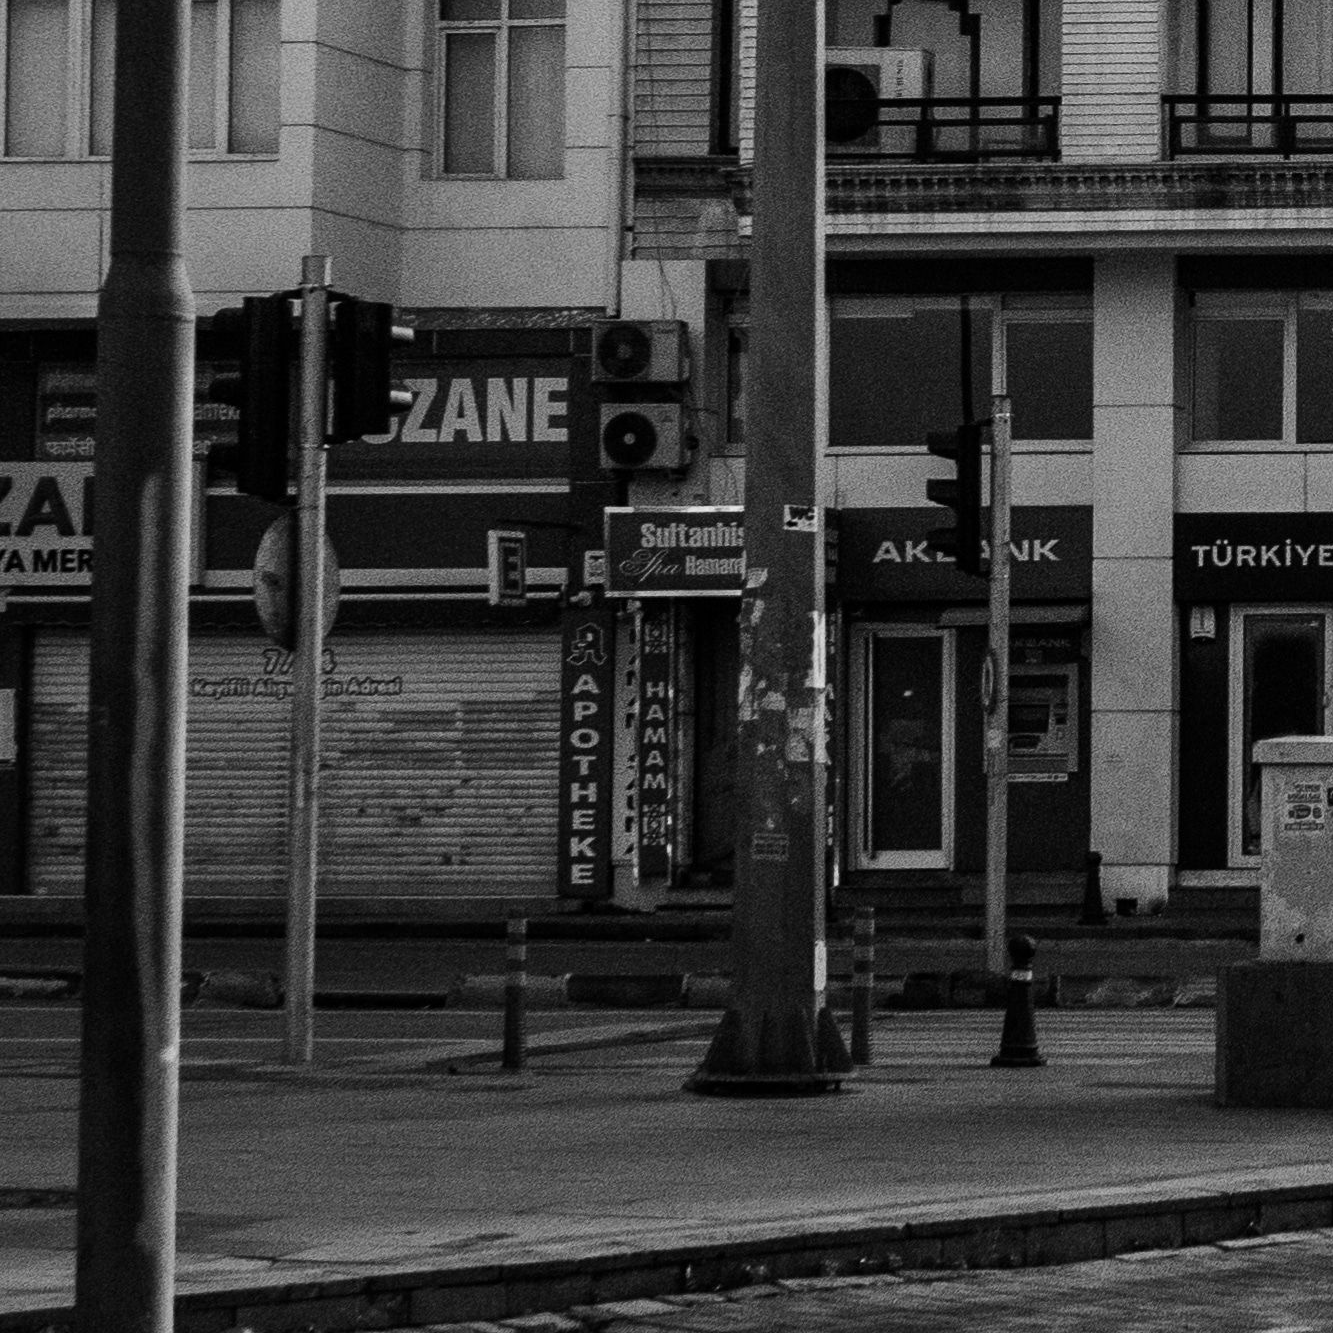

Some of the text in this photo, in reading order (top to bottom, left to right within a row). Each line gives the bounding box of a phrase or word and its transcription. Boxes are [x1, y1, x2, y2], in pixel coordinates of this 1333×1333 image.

[331, 378, 570, 444] ZANE
[618, 548, 683, 583] Spa
[872, 538, 1062, 564] AKNK
[642, 680, 669, 790] HAMAM
[570, 673, 601, 885] APOTHEKE
